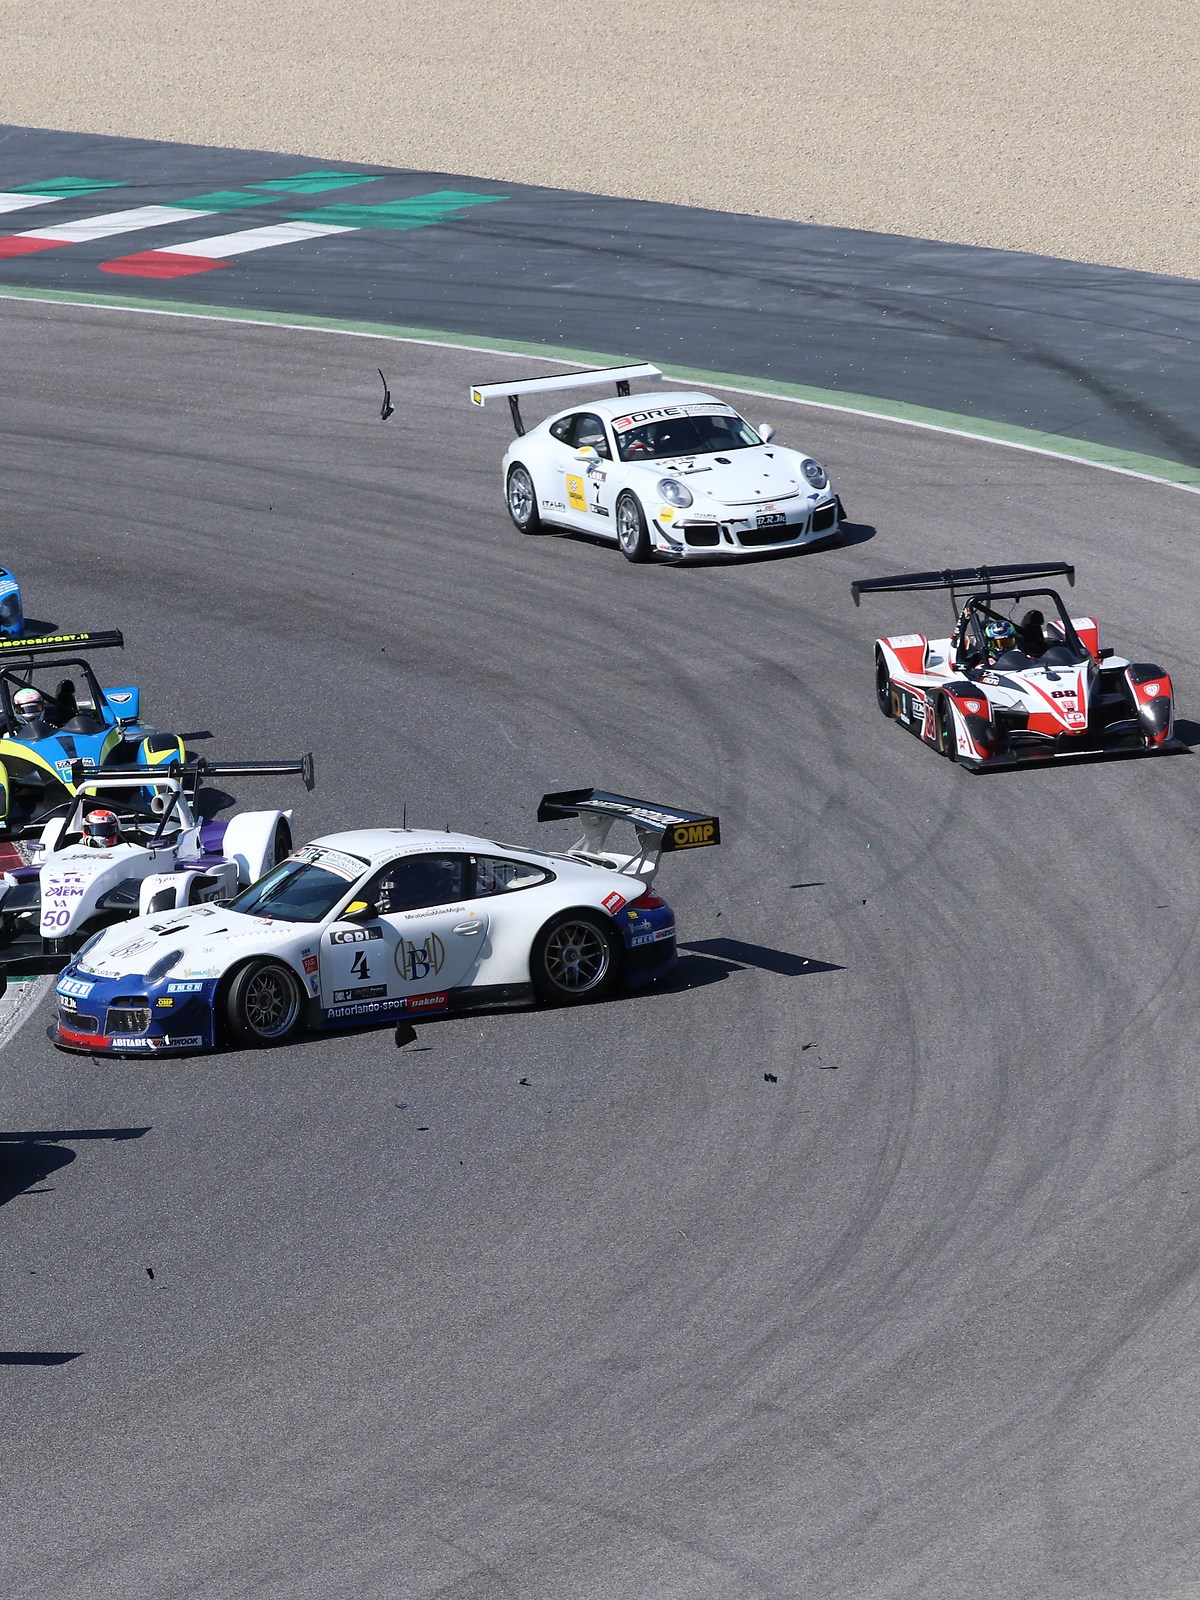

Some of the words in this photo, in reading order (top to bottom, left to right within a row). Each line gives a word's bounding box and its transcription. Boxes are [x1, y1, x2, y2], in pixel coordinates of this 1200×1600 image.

[1051, 690, 1077, 698] 88
[674, 825, 714, 844] OMP
[42, 910, 71, 927] 50
[350, 951, 370, 980] 4
